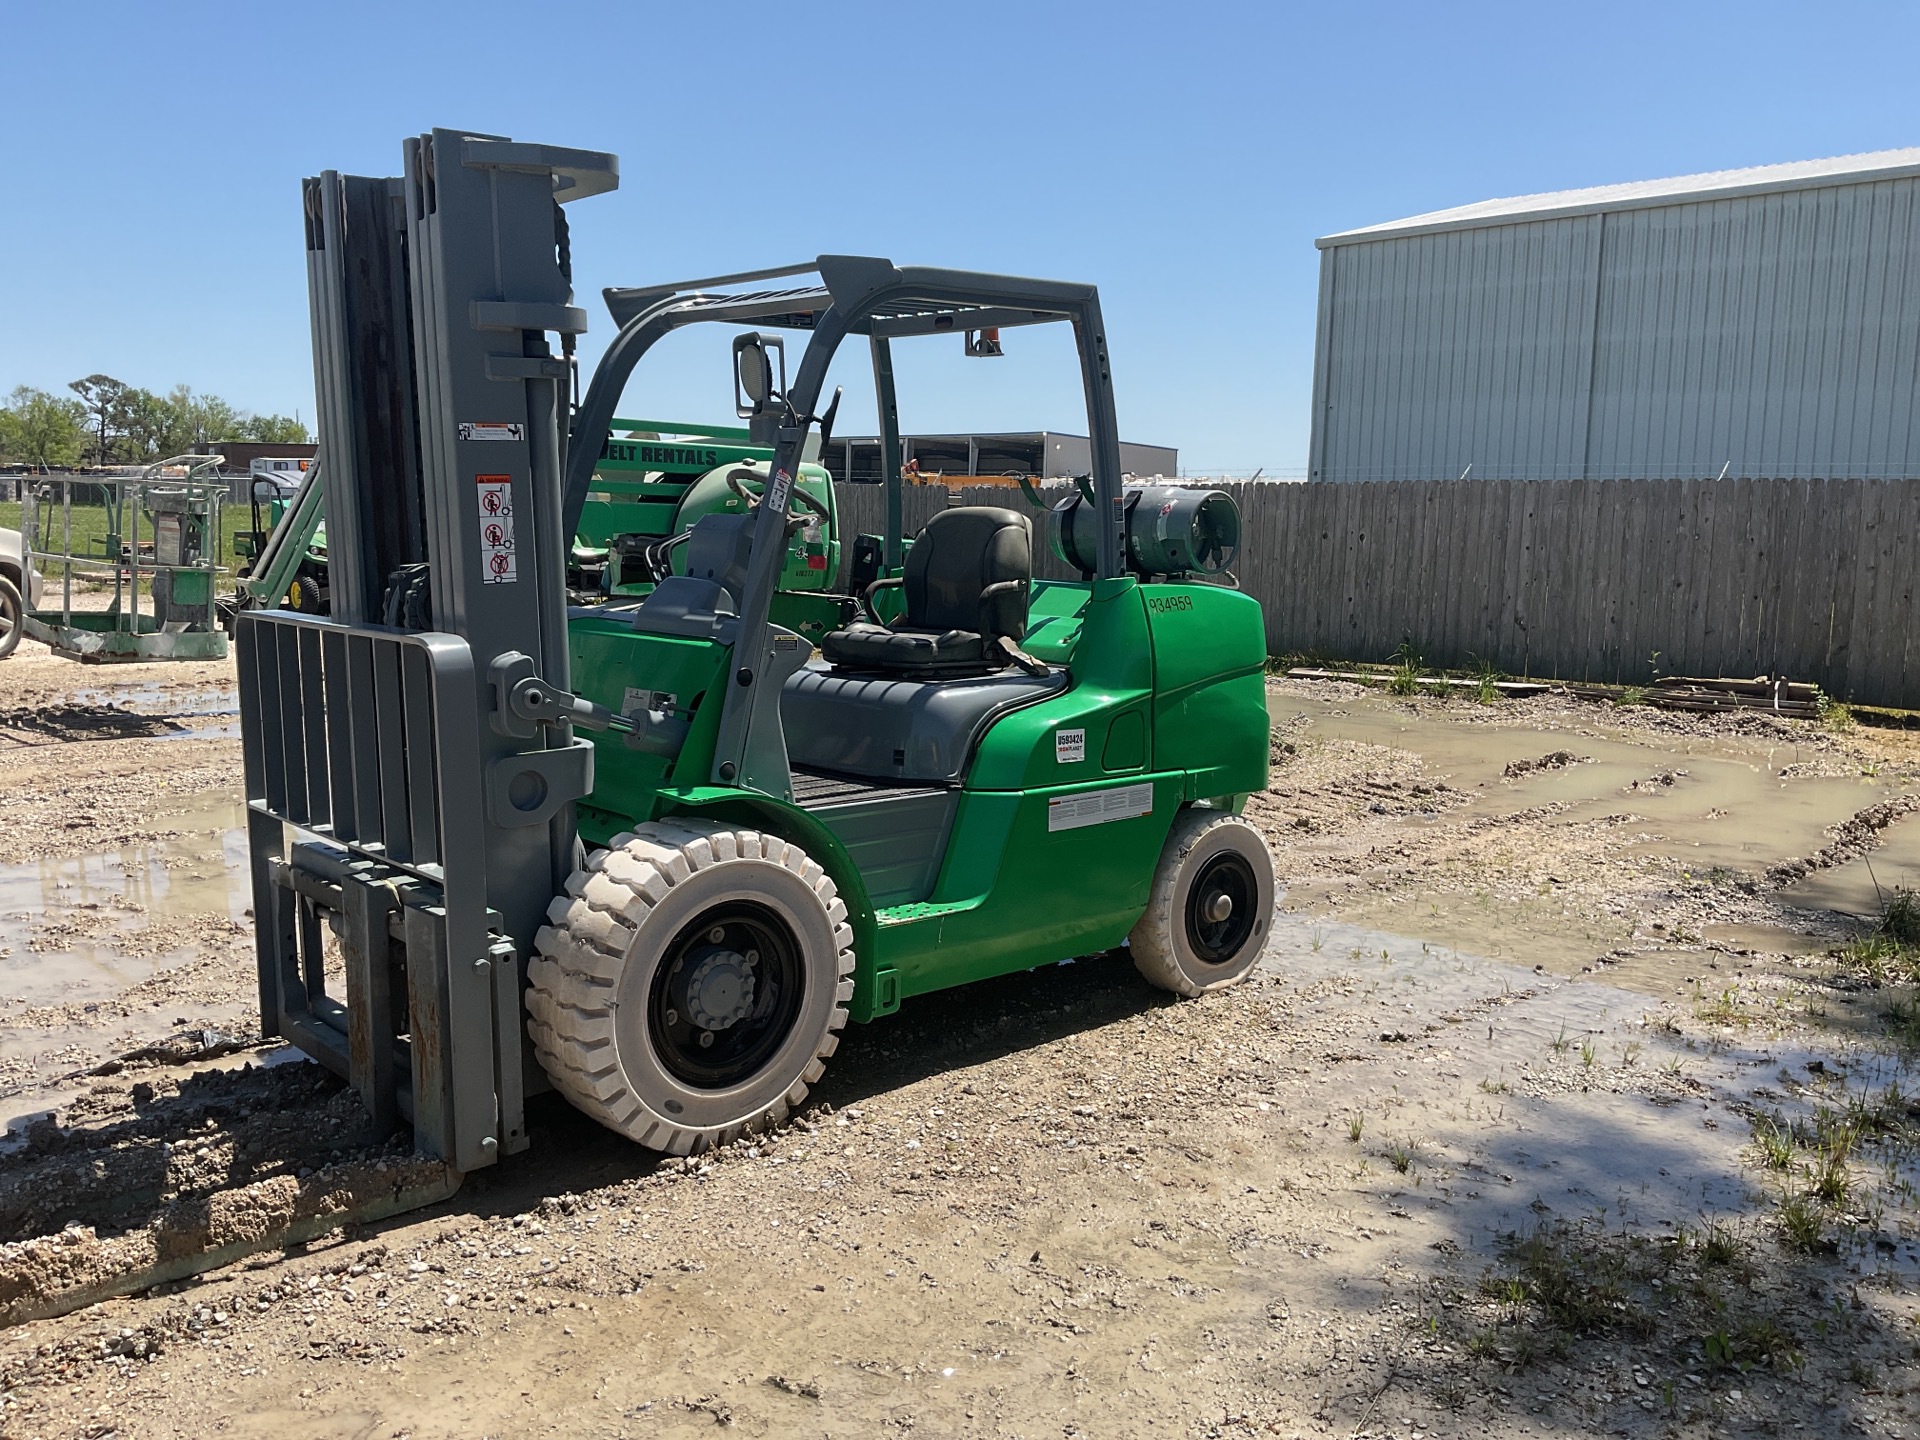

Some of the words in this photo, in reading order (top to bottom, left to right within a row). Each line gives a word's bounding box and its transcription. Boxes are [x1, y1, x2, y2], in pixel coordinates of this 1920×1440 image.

[641, 446, 717, 466] RENTALS
[1149, 596, 1194, 612] 934959
[1057, 734, 1083, 746] U593424
